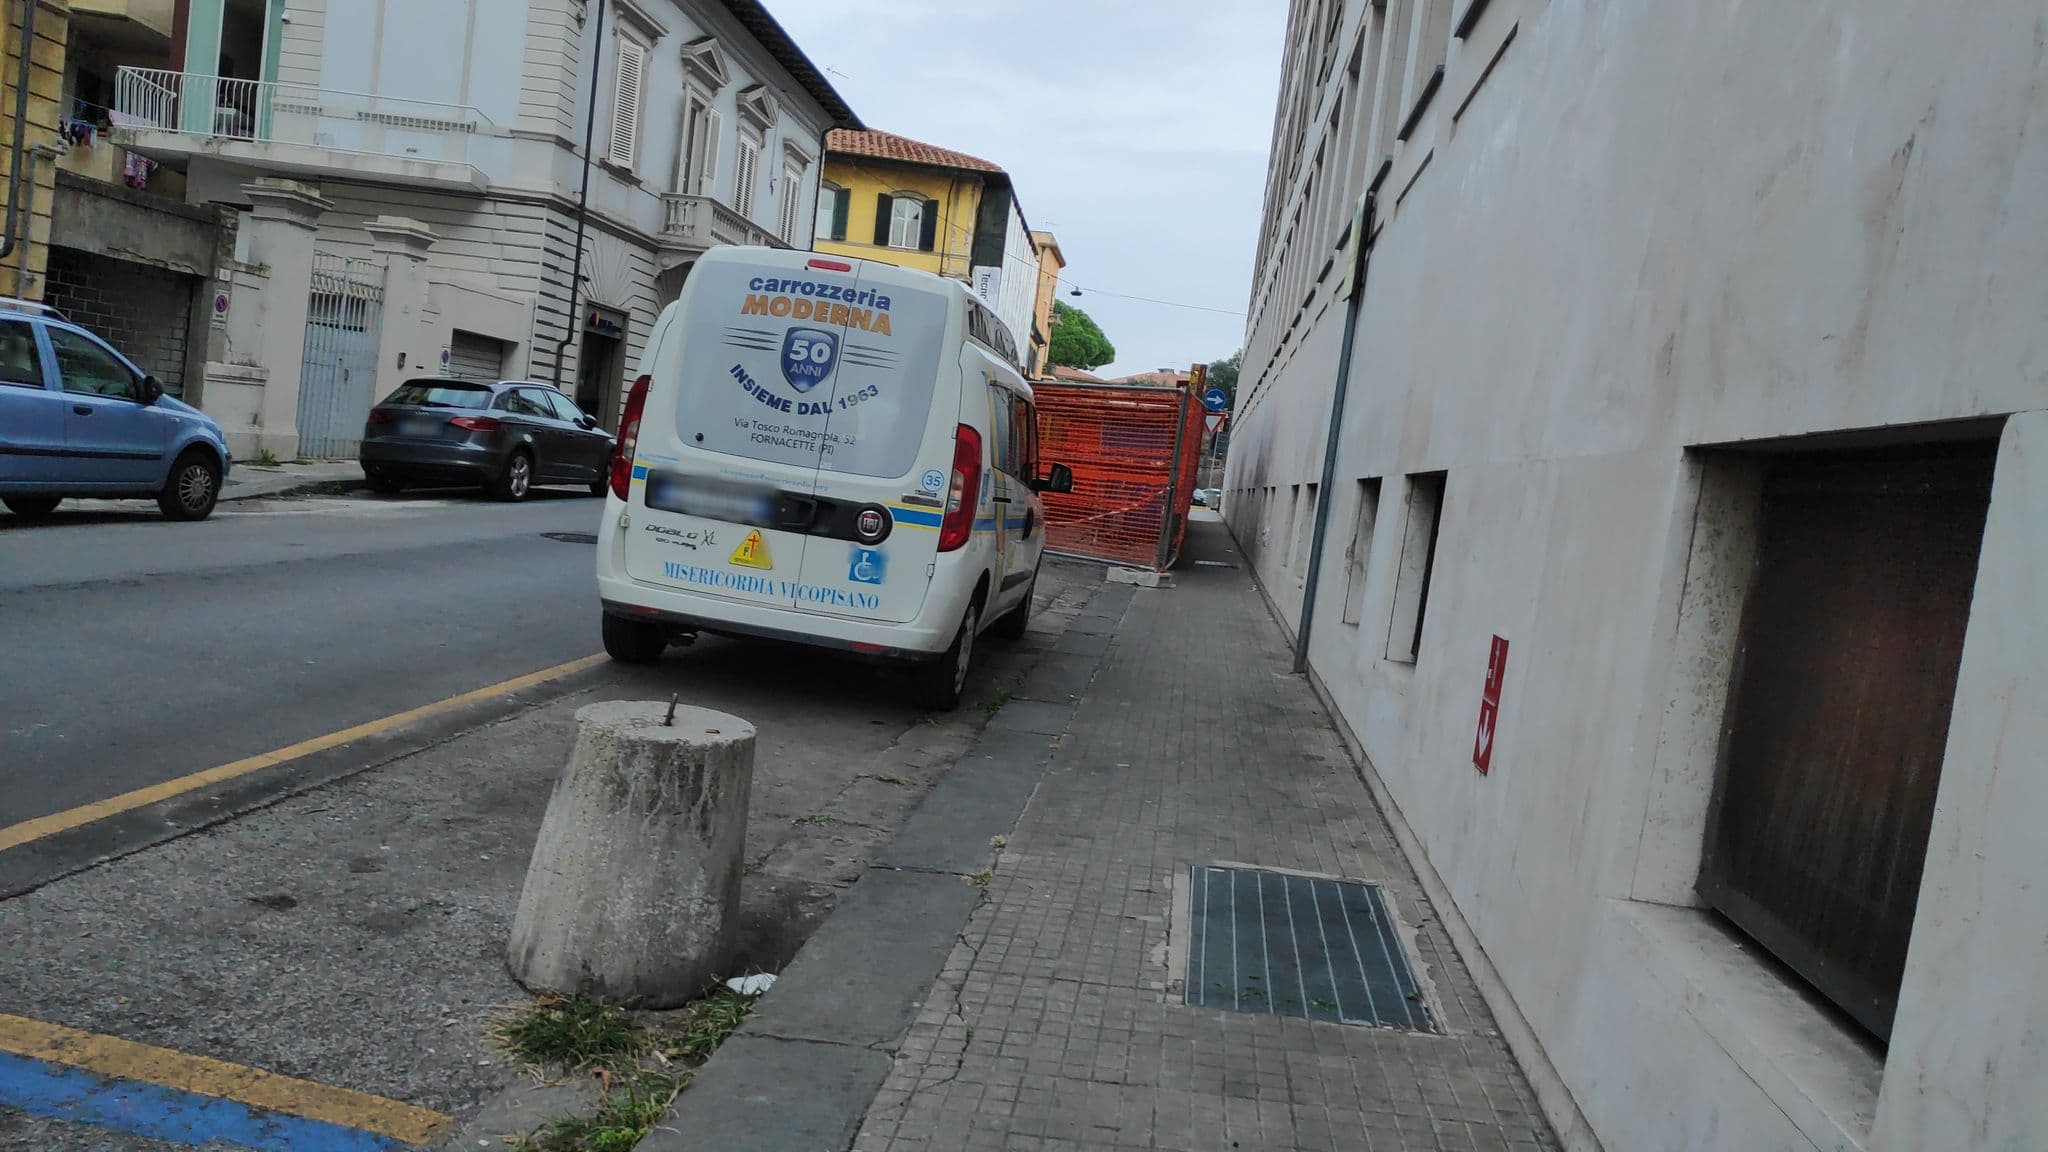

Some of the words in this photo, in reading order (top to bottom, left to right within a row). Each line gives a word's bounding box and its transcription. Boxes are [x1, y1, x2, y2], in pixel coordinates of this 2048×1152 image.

[749, 277, 891, 310] carrozzeria
[741, 294, 892, 336] MODERNA
[789, 339, 831, 364] 50
[789, 362, 822, 377] ANNI
[729, 363, 793, 413] INSIEME
[797, 401, 833, 416] DAL
[838, 384, 880, 410] 1963
[734, 418, 749, 429] Via
[752, 420, 780, 433] Tosco
[750, 432, 818, 452] FORNACETTE
[818, 443, 835, 456] (PI)
[925, 475, 942, 487] 35
[862, 517, 879, 530] FIAT
[701, 529, 717, 546] XL
[663, 560, 774, 596] MISERICORDIA
[781, 581, 879, 610] VICOPISANO
